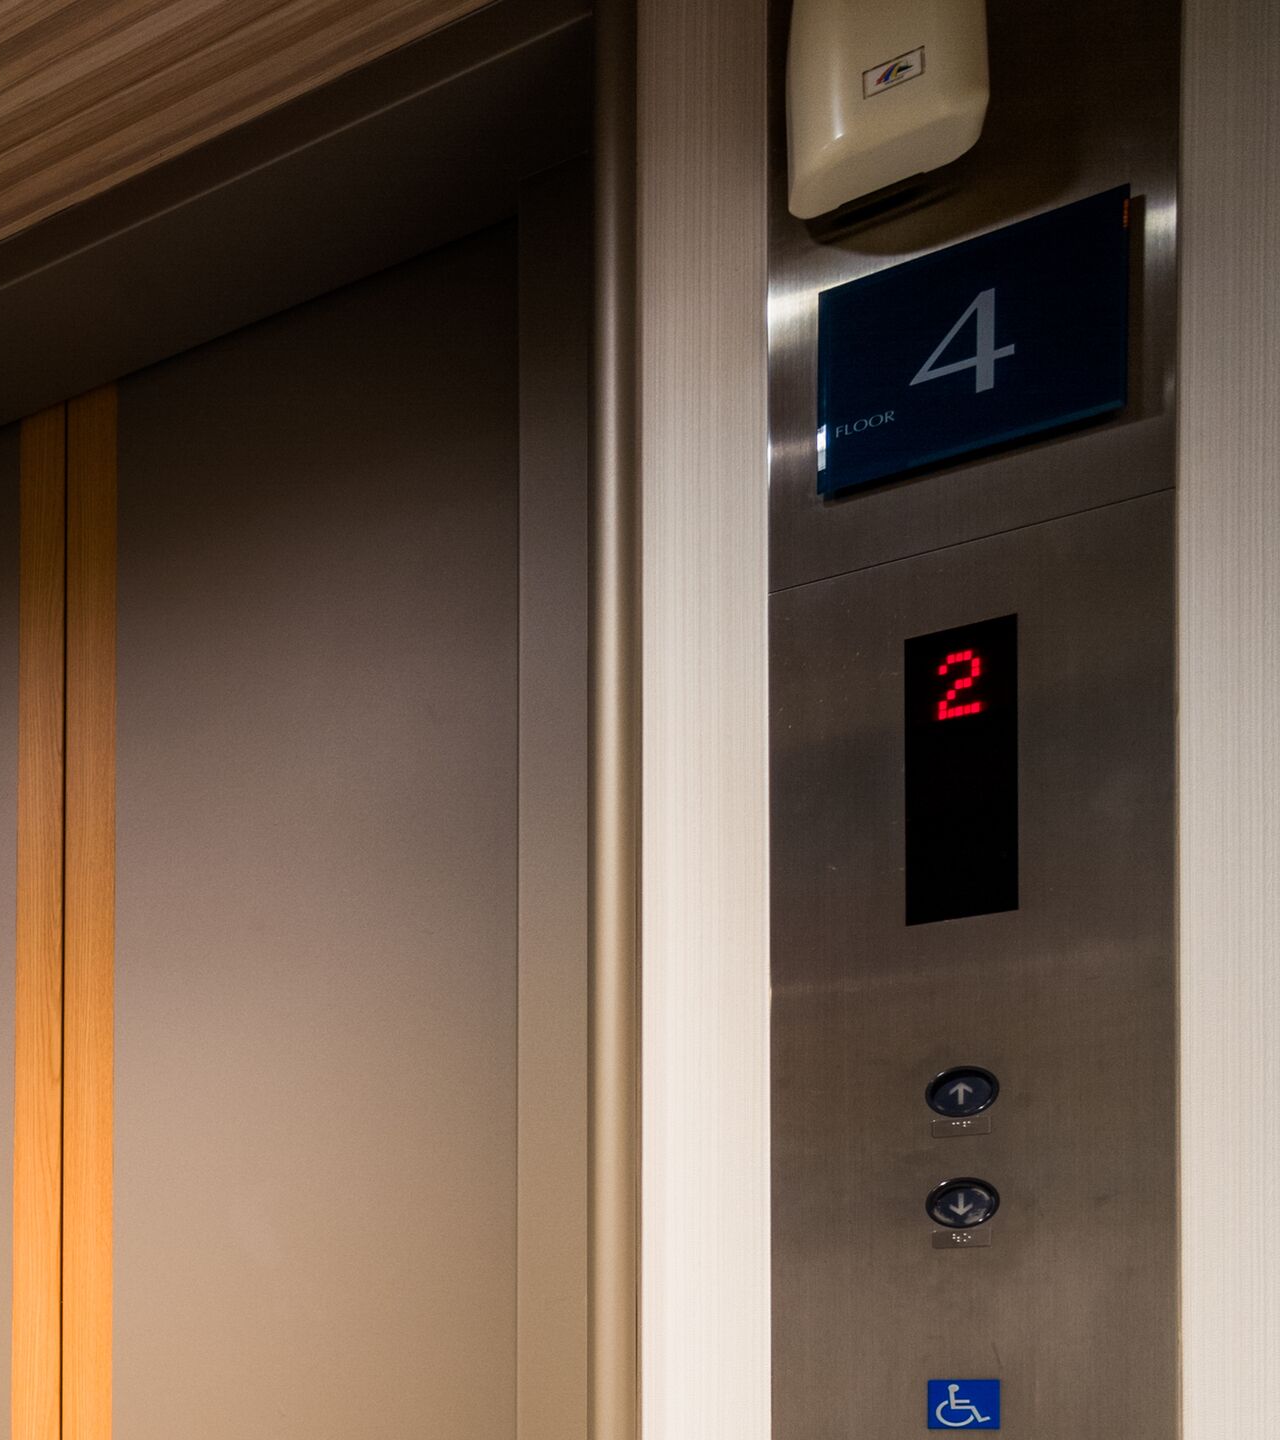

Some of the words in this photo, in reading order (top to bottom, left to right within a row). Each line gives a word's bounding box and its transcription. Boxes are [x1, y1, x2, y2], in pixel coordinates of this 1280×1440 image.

[908, 287, 1015, 394] 4
[834, 410, 896, 438] FLOOR
[937, 649, 982, 721] 2
